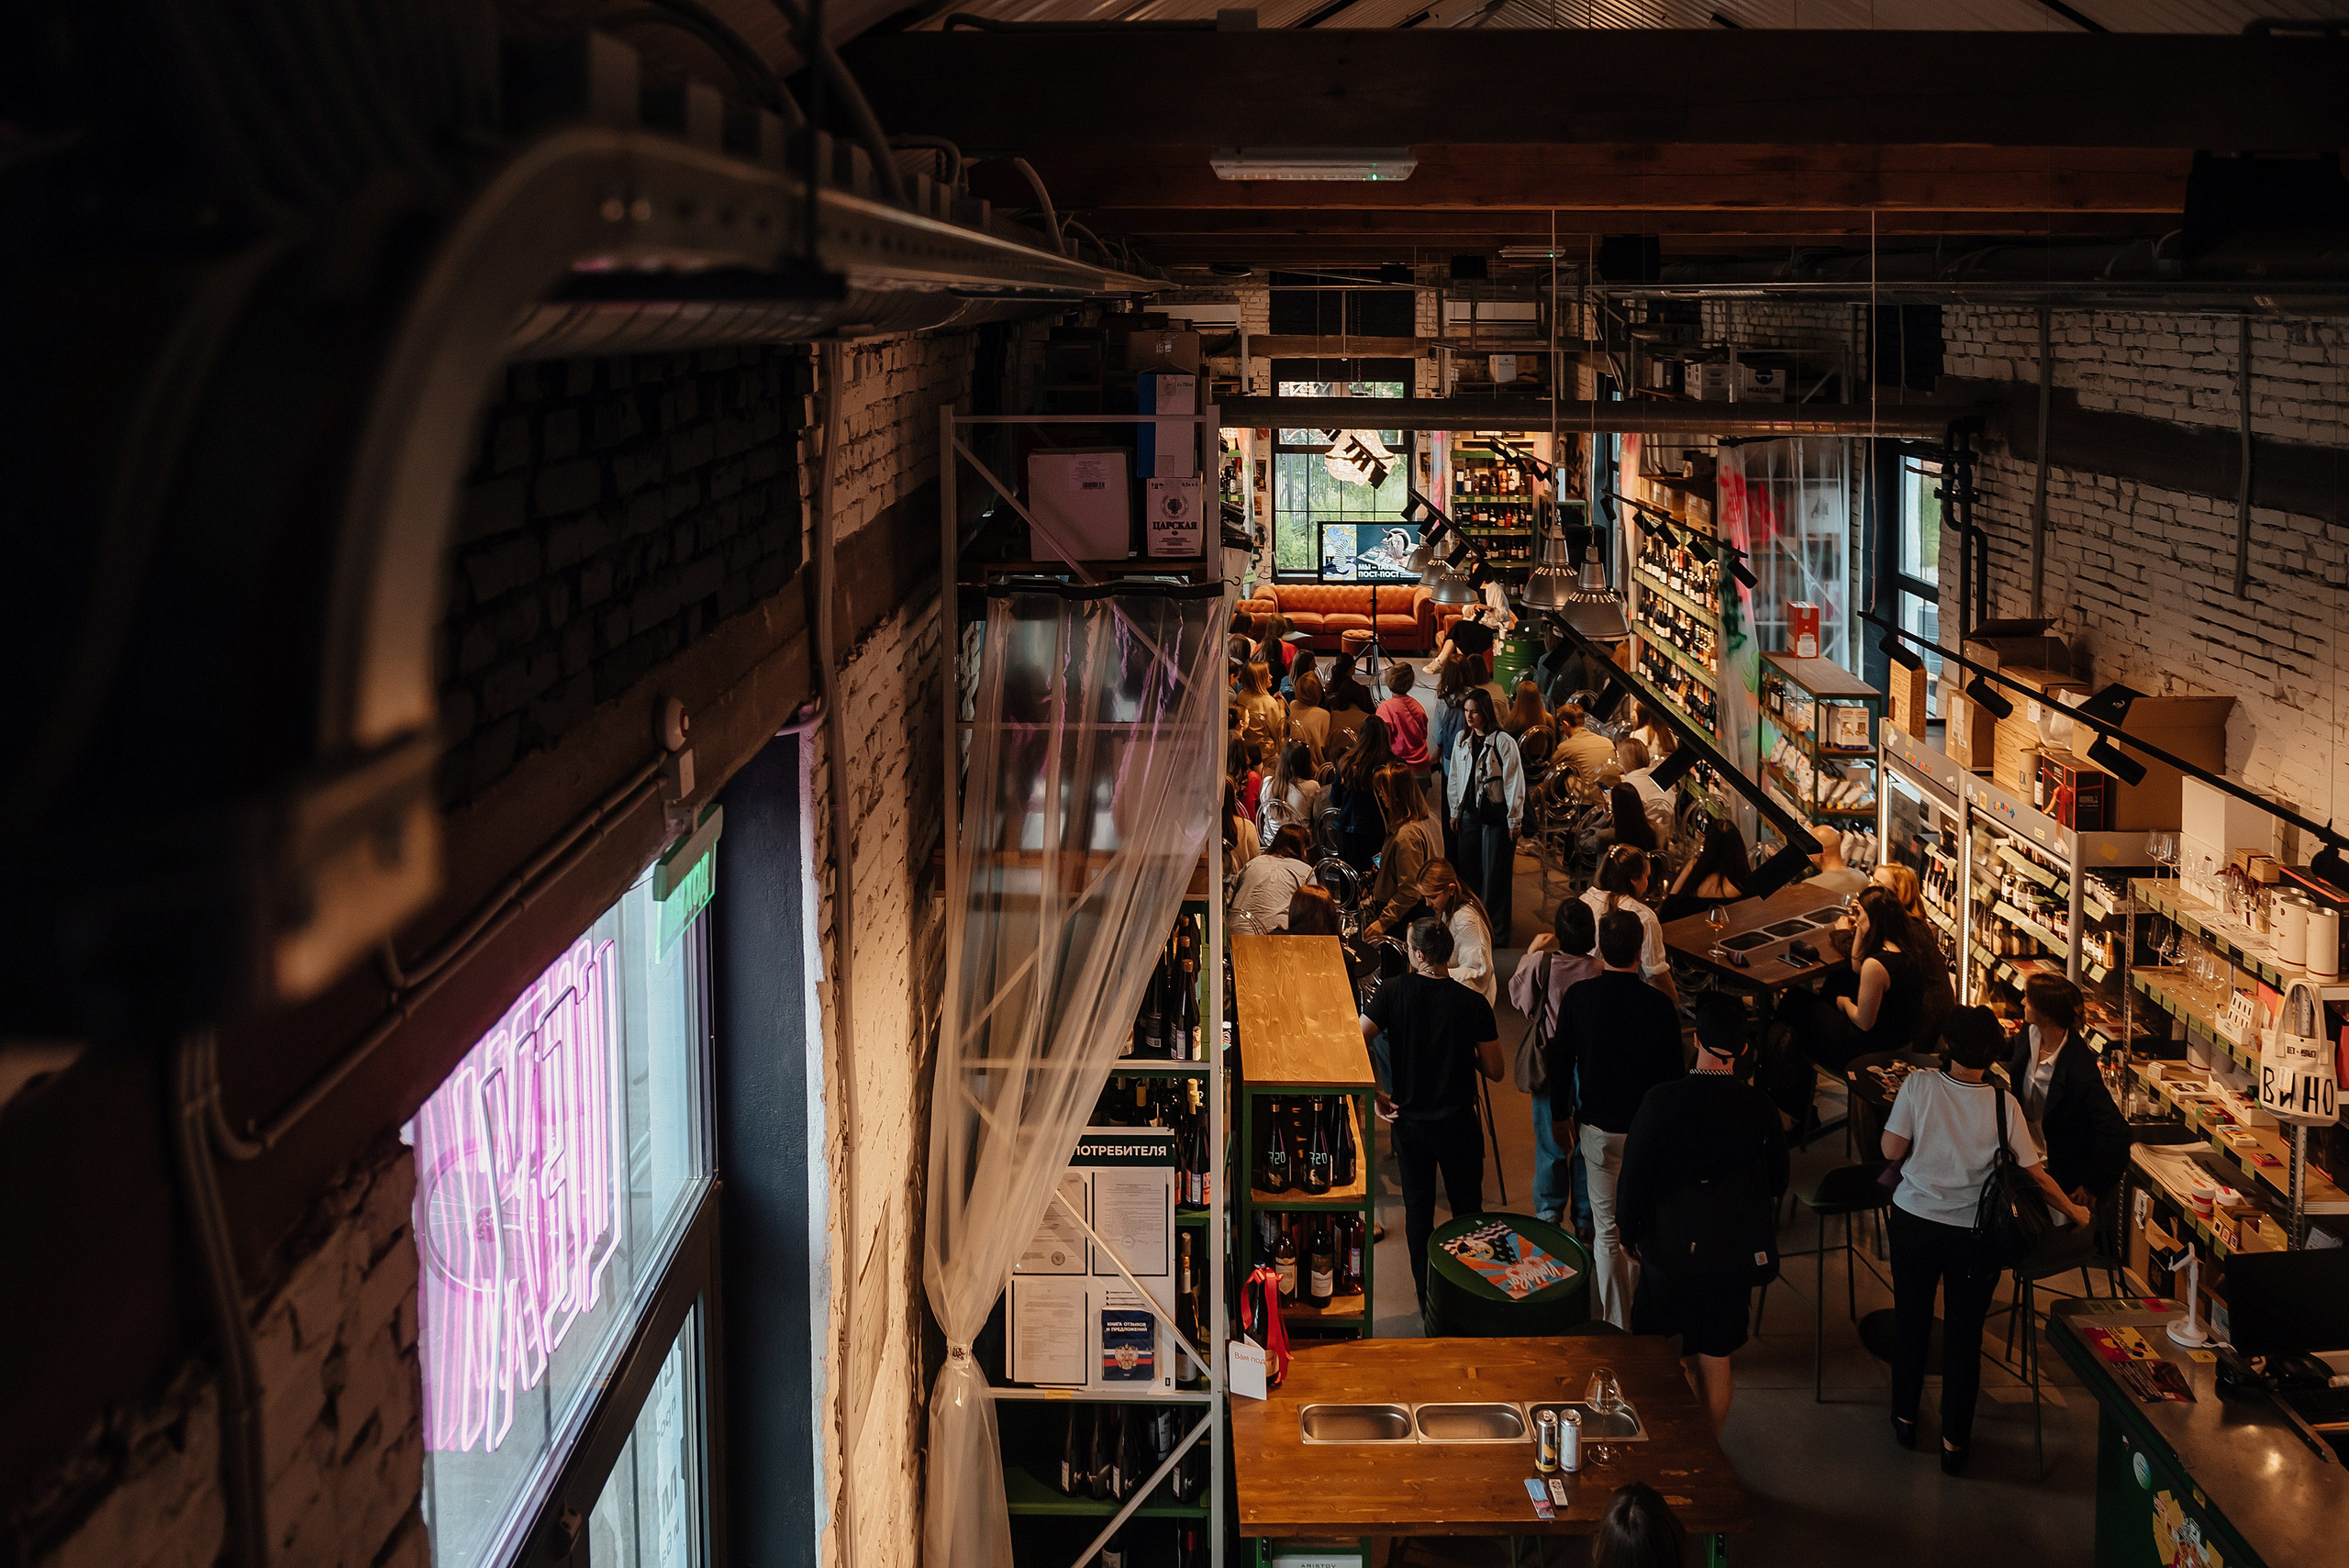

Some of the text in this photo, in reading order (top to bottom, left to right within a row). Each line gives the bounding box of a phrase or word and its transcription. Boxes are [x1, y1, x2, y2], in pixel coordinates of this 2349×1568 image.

[1152, 521, 1197, 531] ЦАРСКАЯ
[1073, 1145, 1167, 1157] ПОТРЕБИТЕЛЯ
[1267, 1151, 1286, 1166] 720
[1308, 1151, 1328, 1167] 720
[1234, 1351, 1250, 1362] Вам
